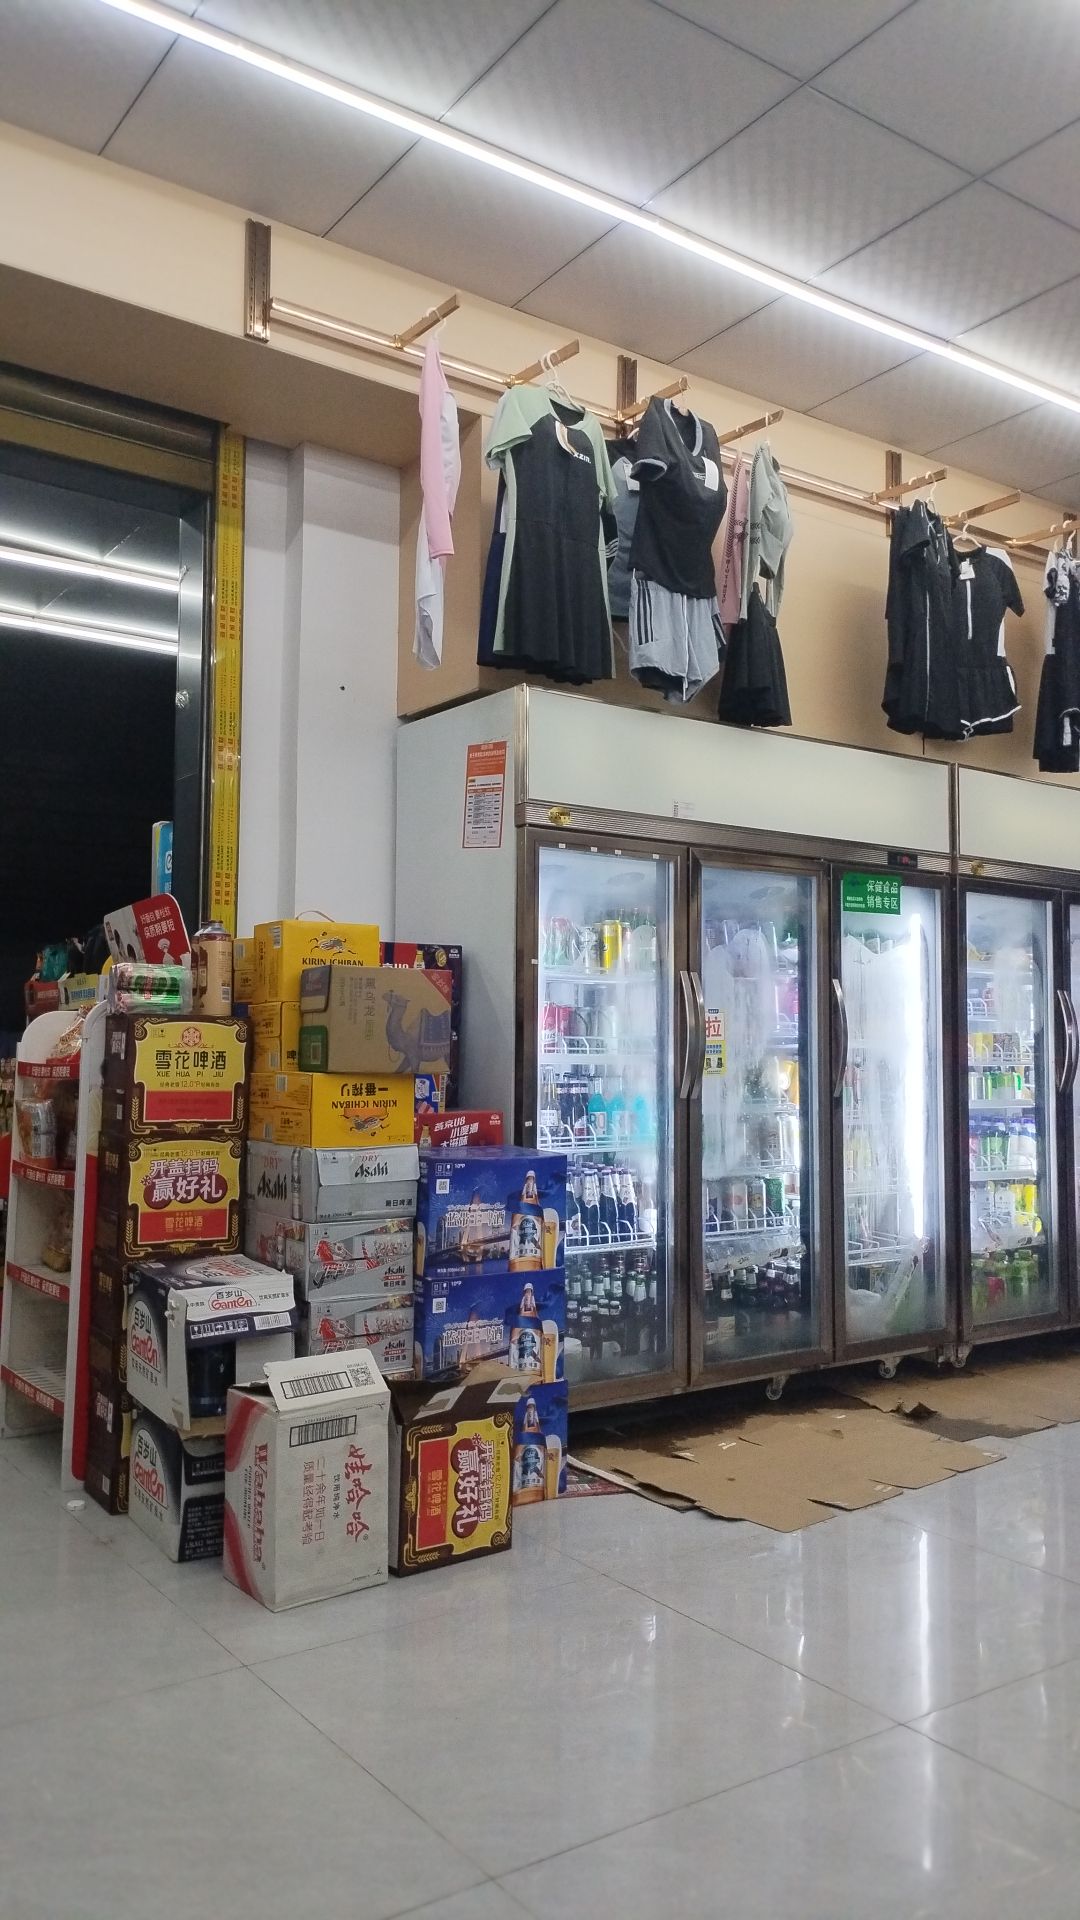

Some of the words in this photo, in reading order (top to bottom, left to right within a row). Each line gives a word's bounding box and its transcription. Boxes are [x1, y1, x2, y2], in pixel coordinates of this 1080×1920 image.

[866, 880, 898, 894] 保健食品
[866, 895, 899, 909] 销售专区
[302, 957, 327, 966] KIRIN
[705, 1016, 722, 1038] 拉
[155, 1050, 226, 1070] 雪花啤酒
[156, 1070, 170, 1078] XUE
[176, 1070, 190, 1078] HUA
[197, 1070, 204, 1078] PI
[213, 1070, 224, 1078] JIU
[331, 1100, 369, 1109] ICHIBAN
[372, 1099, 398, 1108] KIRIN
[450, 1122, 479, 1139] 小度酒
[150, 1159, 219, 1177] 开盖扫码
[355, 1161, 388, 1178] Asahi
[151, 1175, 223, 1202] 赢好礼
[257, 1171, 288, 1201] Asahi
[165, 1216, 204, 1229] 雪花啤酒
[384, 1265, 405, 1275] Asahi
[211, 1297, 253, 1311] Ganten
[216, 1290, 243, 1300] 百岁山
[134, 1306, 152, 1334] 百岁山
[131, 1324, 158, 1368] Ganten
[384, 1339, 406, 1350] Asahi
[137, 1434, 157, 1467] 百岁山
[132, 1452, 164, 1505] Ganten
[478, 1439, 494, 1523] 开盖扫码
[314, 1456, 327, 1542] 二十余年如一日
[332, 1473, 341, 1520] 饮用纯净水
[345, 1444, 373, 1543] 娃哈哈
[431, 1469, 443, 1517] 雪花啤酒
[455, 1447, 480, 1533] 赢好礼
[251, 1442, 268, 1563] Wahaha
[302, 1461, 315, 1545] 质量经得起考验
